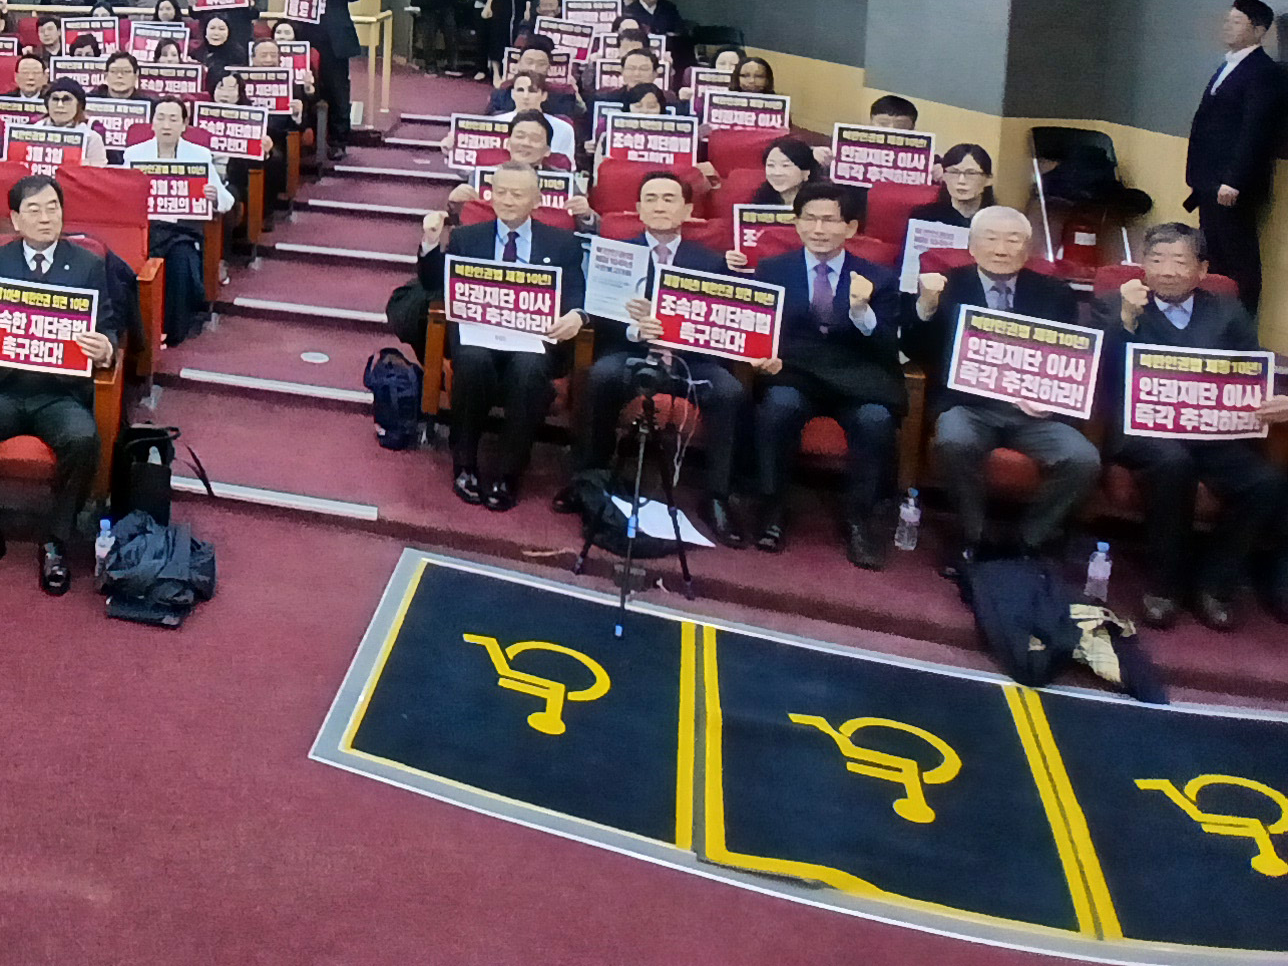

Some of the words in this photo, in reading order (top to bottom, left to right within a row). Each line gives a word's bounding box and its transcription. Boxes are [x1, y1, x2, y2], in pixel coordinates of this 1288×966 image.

[454, 282, 513, 306] 인권재단
[514, 291, 551, 312] 이사
[660, 294, 707, 321] 조속한
[2, 336, 63, 364] 촉구한다!
[967, 337, 1042, 371] 인권재단
[1046, 353, 1085, 381] 이사
[1001, 370, 1084, 407] 추천하라!
[1139, 377, 1218, 403] 인권재단
[1222, 383, 1261, 405] 이사
